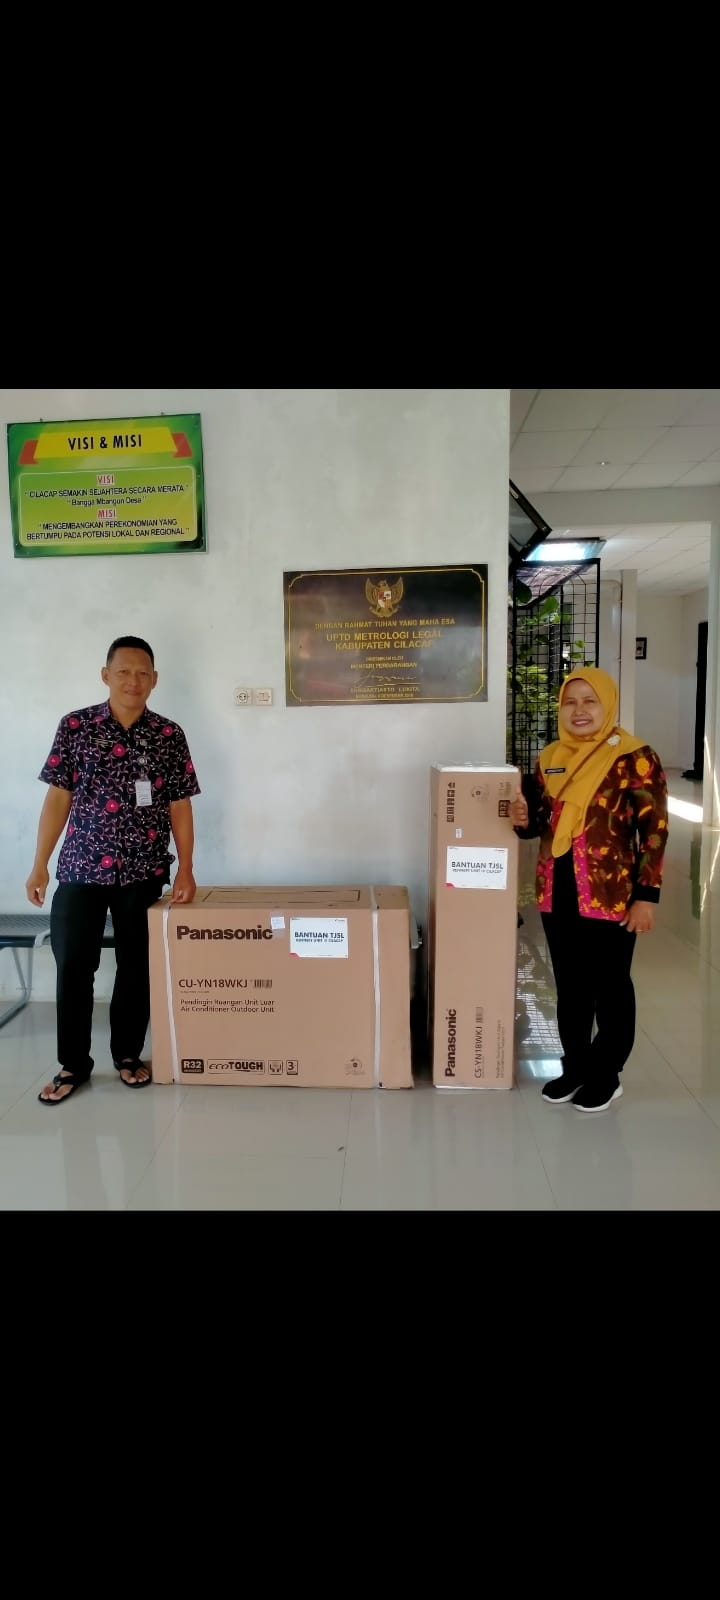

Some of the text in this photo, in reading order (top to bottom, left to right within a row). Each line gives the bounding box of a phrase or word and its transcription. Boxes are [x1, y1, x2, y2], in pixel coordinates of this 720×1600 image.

[68, 434, 142, 450] VISI & MISI
[97, 475, 114, 484] VISI
[30, 490, 57, 498] CILACAP
[59, 489, 88, 497] SEMAKIN
[90, 487, 127, 496] SEJAHTERA
[129, 486, 156, 494] SECARA
[157, 485, 184, 493] MERATA
[96, 498, 124, 507] Mbangun
[98, 509, 116, 518] MISI
[105, 520, 158, 528] PEREKONOMIAN
[160, 518, 177, 526] YANG
[27, 532, 62, 540] BERTUMPU
[83, 530, 110, 538] POTENSI
[112, 529, 134, 537] LOKAL
[151, 527, 184, 536] REGIONAL
[344, 621, 372, 629] RAHMAT
[375, 620, 396, 628] TUHAN
[326, 630, 442, 642] UPTD METROLOGI LEGAL
[336, 640, 434, 650] KABUPATEN CILACAP
[176, 925, 274, 940] Panasonic
[178, 979, 248, 988] CU-YN18WKJ
[180, 998, 212, 1006] Pendingin
[445, 1009, 456, 1077] Panasonic
[474, 1027, 482, 1078] CS-YN18WKJ
